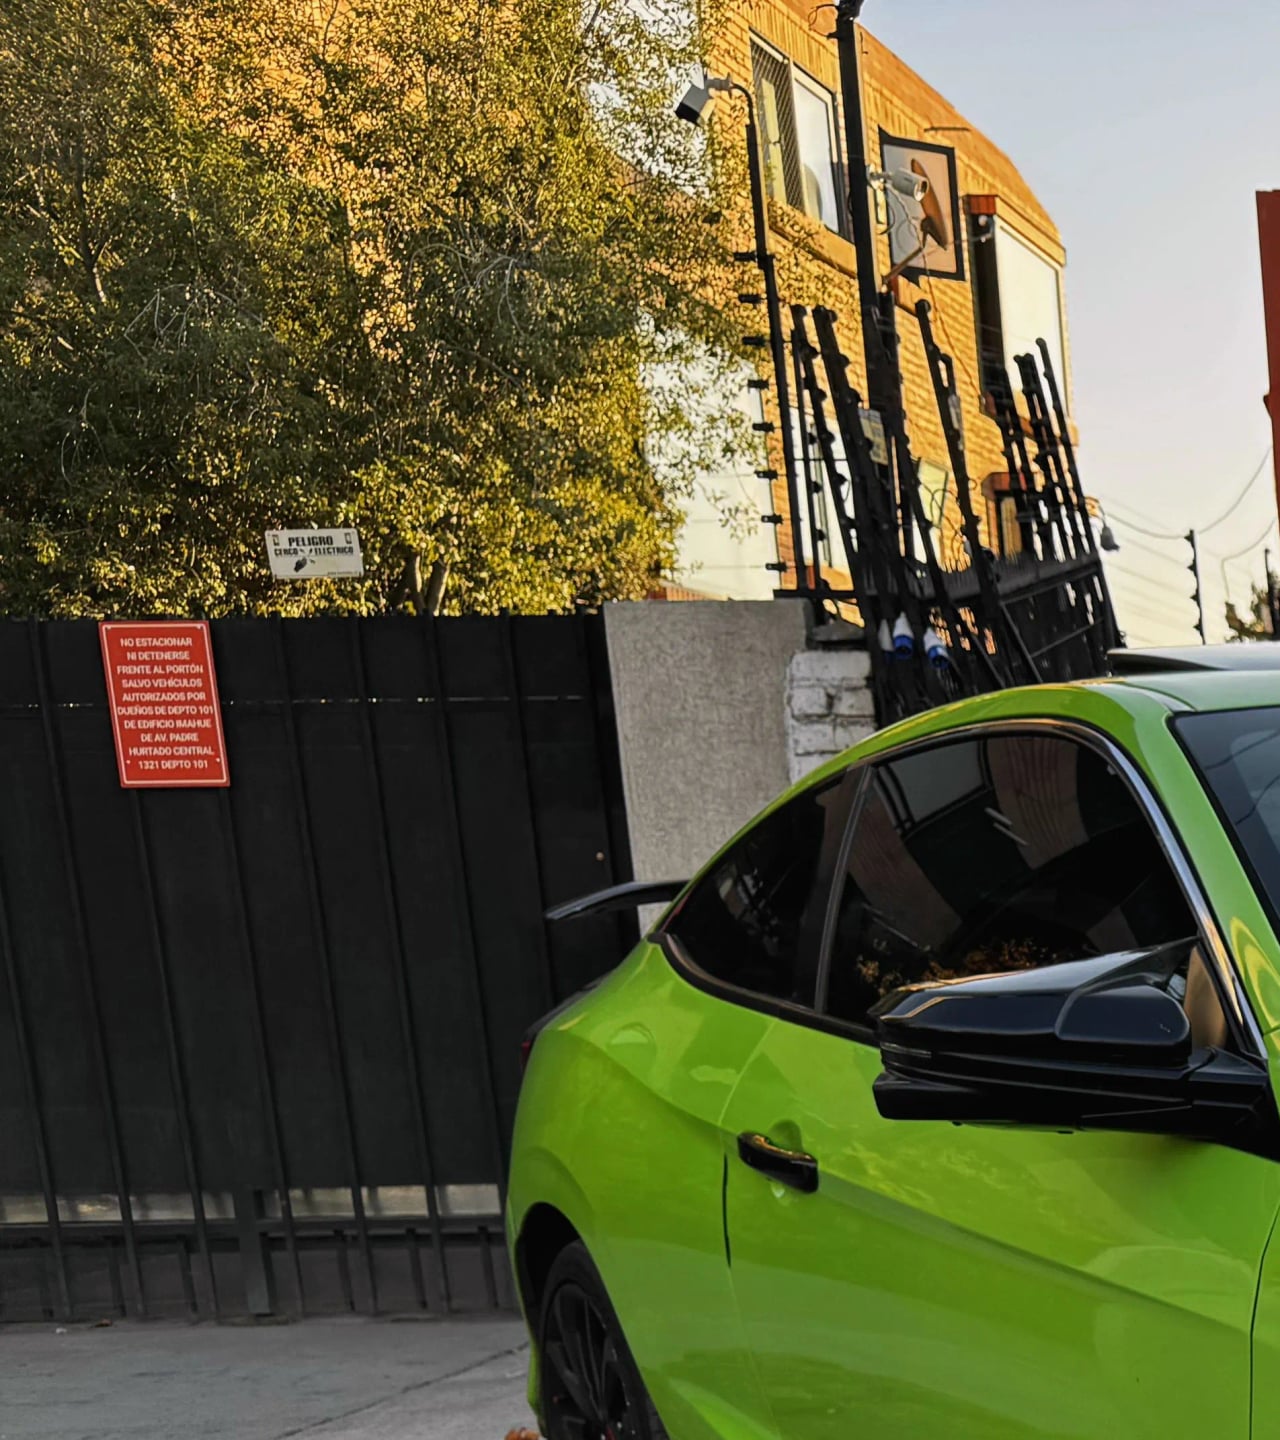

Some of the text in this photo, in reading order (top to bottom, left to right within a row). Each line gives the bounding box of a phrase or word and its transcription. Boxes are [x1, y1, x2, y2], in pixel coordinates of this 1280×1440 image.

[288, 536, 333, 547] PELIGRO
[120, 637, 192, 647] NO ESTACIONAR
[127, 651, 190, 660] NI DETENERSE
[117, 665, 151, 675] FRENTE
[153, 665, 164, 674] AL
[122, 679, 151, 688] SALVO
[122, 692, 206, 702] AUTORIZADOS POR
[155, 706, 167, 715] DE
[168, 706, 197, 714] DEPTO
[199, 706, 213, 714] 101
[124, 720, 136, 729] DE
[138, 720, 174, 728] EDIFICIO
[141, 733, 199, 742] DE AV. PADRE
[128, 746, 214, 756] HURTADO CENTRAL
[138, 760, 208, 769] 1321 DEPTO 101
